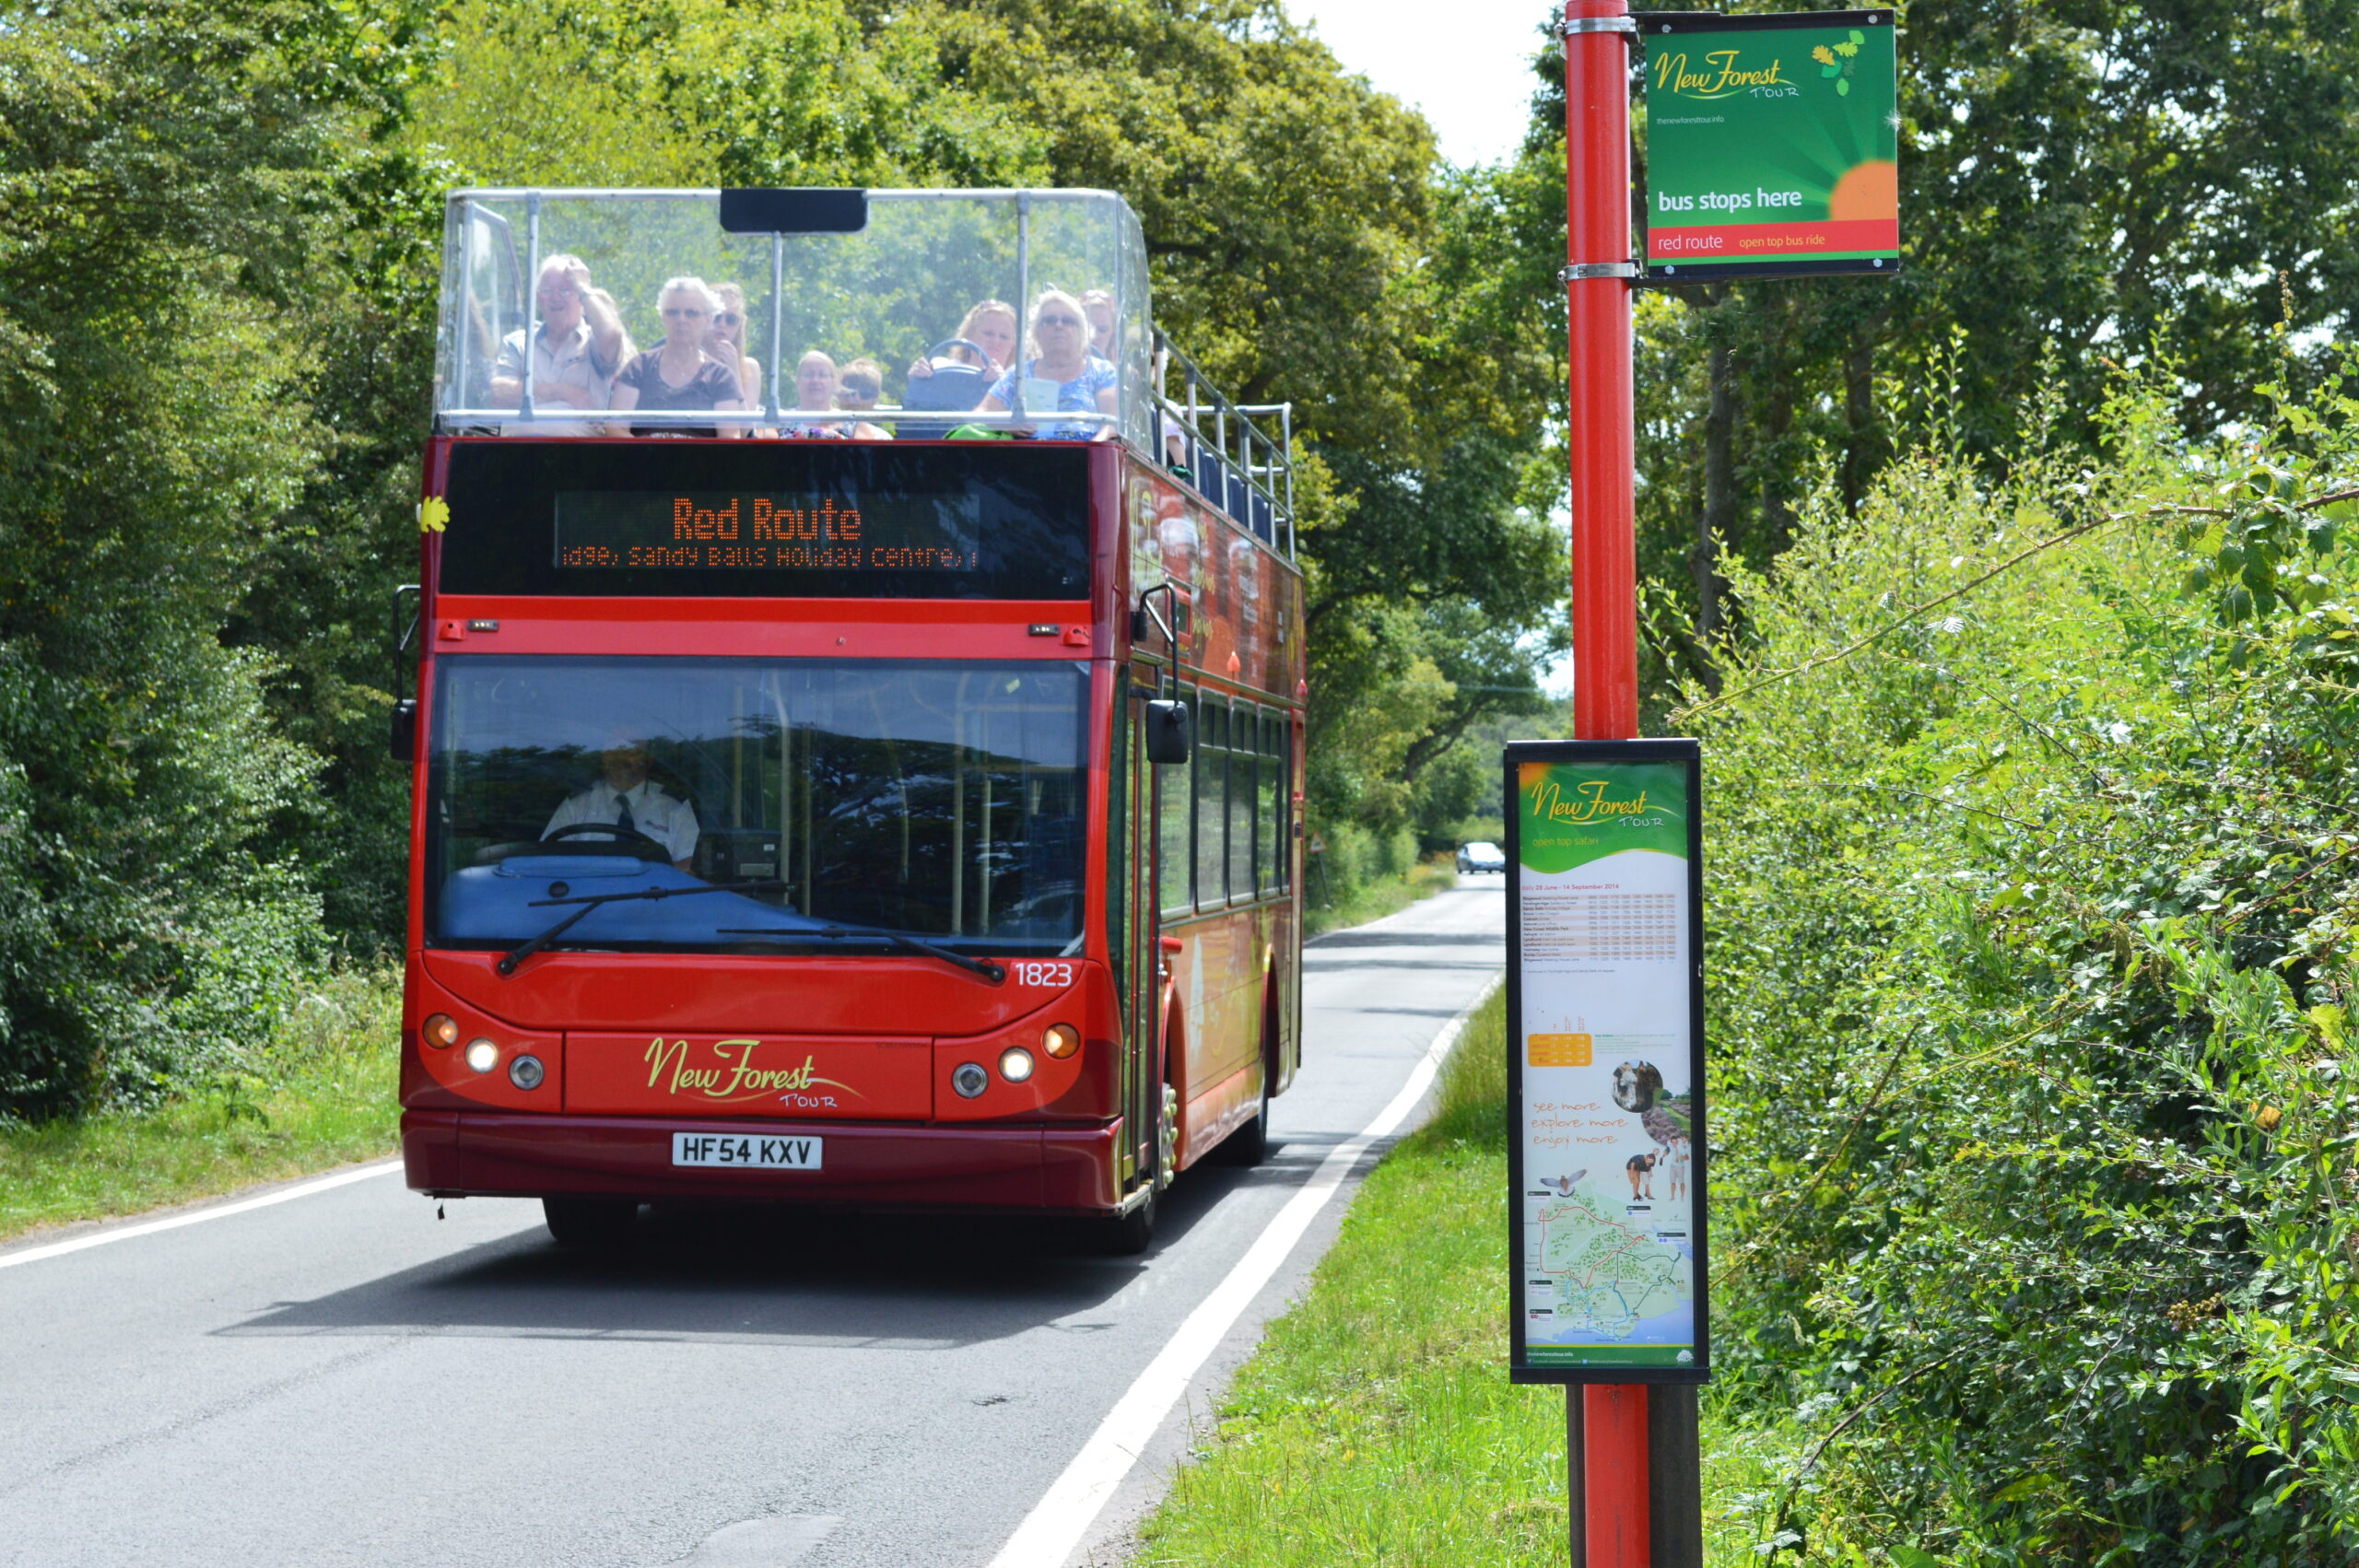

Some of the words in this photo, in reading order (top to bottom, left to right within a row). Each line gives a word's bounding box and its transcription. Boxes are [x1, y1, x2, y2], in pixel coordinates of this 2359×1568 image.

[1655, 53, 1711, 93] New
[1699, 50, 1780, 93] Forest
[1750, 87, 1799, 98] TOUR
[1656, 115, 1725, 125] thenewforesttour.info
[1659, 191, 1694, 211] bus
[1699, 191, 1751, 214] stops
[1757, 187, 1802, 208] here
[1659, 235, 1682, 251] red
[1685, 235, 1723, 250] route
[1739, 237, 1765, 250] open
[1767, 236, 1783, 248] top
[1786, 235, 1803, 246] bus
[1805, 234, 1825, 245] ride
[674, 497, 738, 540] Red
[754, 497, 862, 540] Route
[563, 546, 618, 566] idge,
[709, 546, 767, 567] Balls
[777, 547, 861, 567] Holiday
[1531, 782, 1583, 820] New
[1571, 781, 1647, 820] Forest
[1618, 816, 1664, 827] TOUR
[1532, 837, 1555, 847] open
[1557, 837, 1571, 847] top
[1574, 836, 1600, 846] safari
[1571, 883, 1603, 892] September
[1015, 963, 1073, 987] 1823
[644, 1037, 721, 1094] New
[703, 1039, 815, 1096] Forest
[780, 1094, 838, 1107] TOUR
[1533, 1102, 1558, 1113] see
[1562, 1102, 1601, 1111] more
[1532, 1113, 1584, 1133] explore
[1589, 1118, 1629, 1128] more
[683, 1137, 751, 1163] HF54
[760, 1140, 811, 1164] KXV
[1533, 1135, 1569, 1150] enjoy
[1577, 1135, 1619, 1144] more
